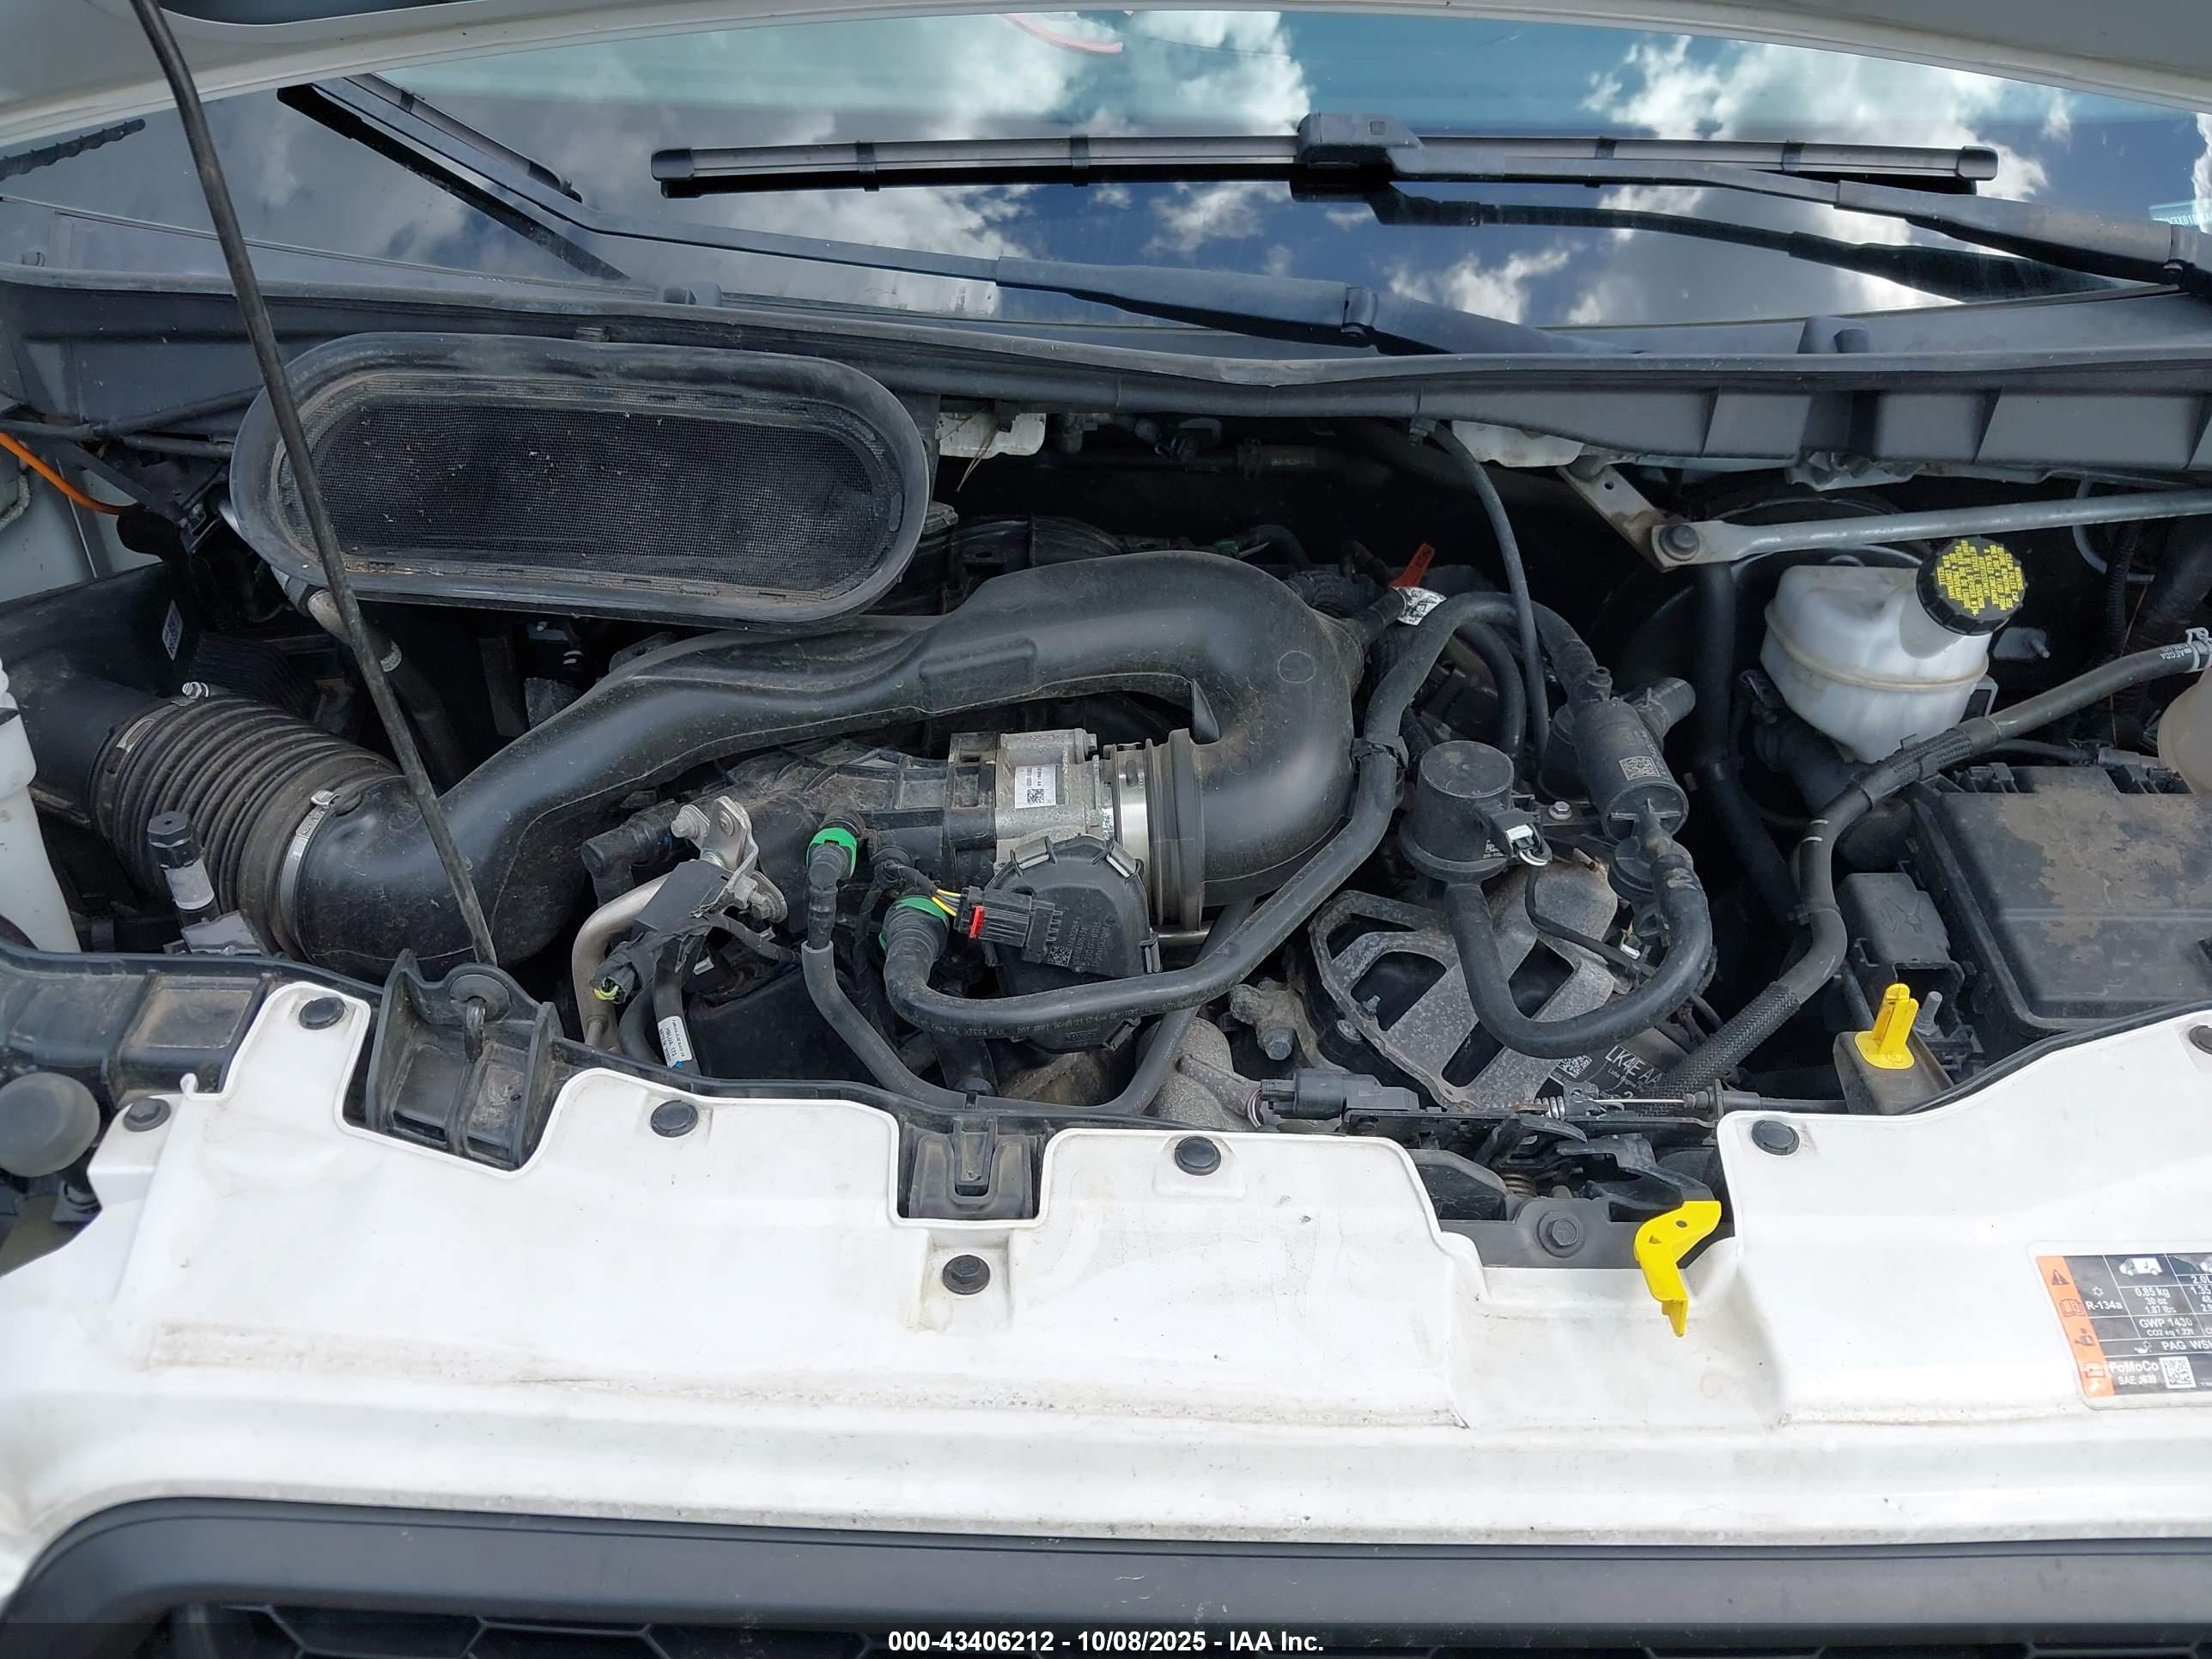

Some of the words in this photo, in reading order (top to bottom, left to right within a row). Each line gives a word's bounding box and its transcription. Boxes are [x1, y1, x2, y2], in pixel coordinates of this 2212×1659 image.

[2135, 1286, 2156, 1297] 0.85
[2155, 1286, 2171, 1298] kg
[2085, 1299, 2124, 1310] R-134a
[2145, 1297, 2156, 1305] 30
[2139, 1317, 2165, 1328] GWP
[2167, 1317, 2193, 1327] 1430
[2160, 1340, 2187, 1351] PAG
[2109, 1360, 2159, 1373] FoMoCo
[2118, 1375, 2137, 1385] SAE
